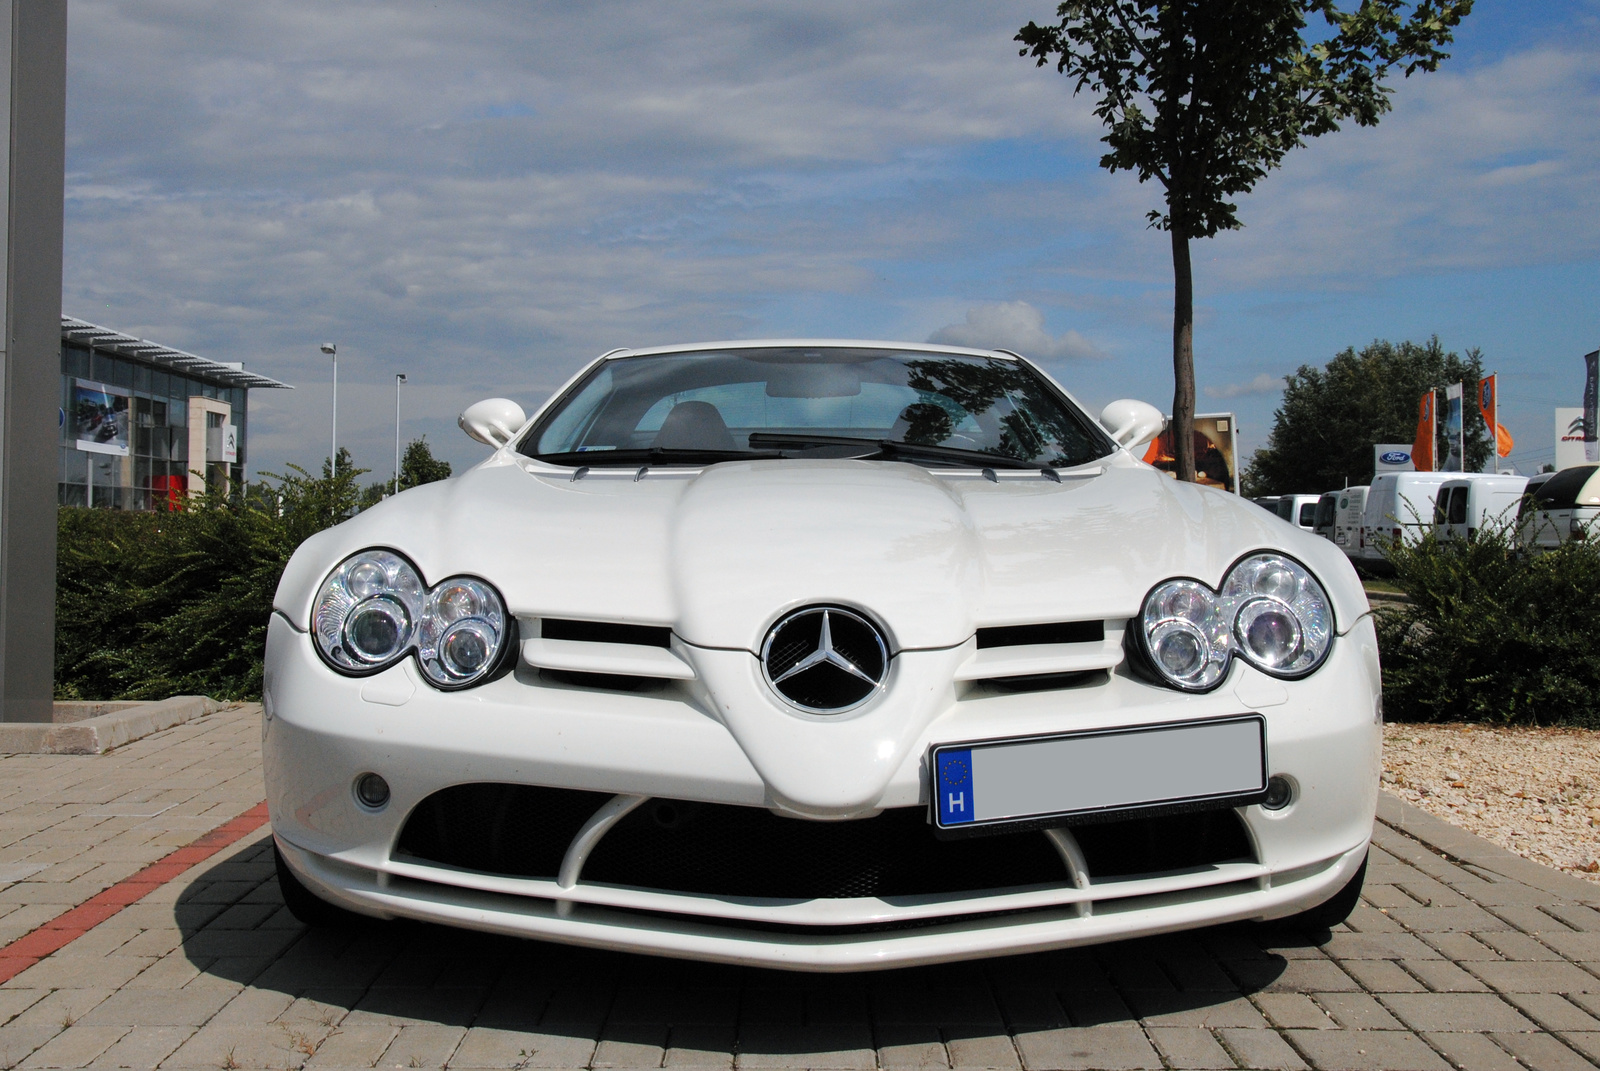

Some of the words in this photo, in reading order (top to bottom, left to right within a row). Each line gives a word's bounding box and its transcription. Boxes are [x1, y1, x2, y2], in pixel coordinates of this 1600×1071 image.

[1387, 452, 1405, 461] Ford
[949, 792, 964, 813] H
[1116, 807, 1163, 820] PREMIUM
[1166, 800, 1225, 814] AUTOMOTIVE
